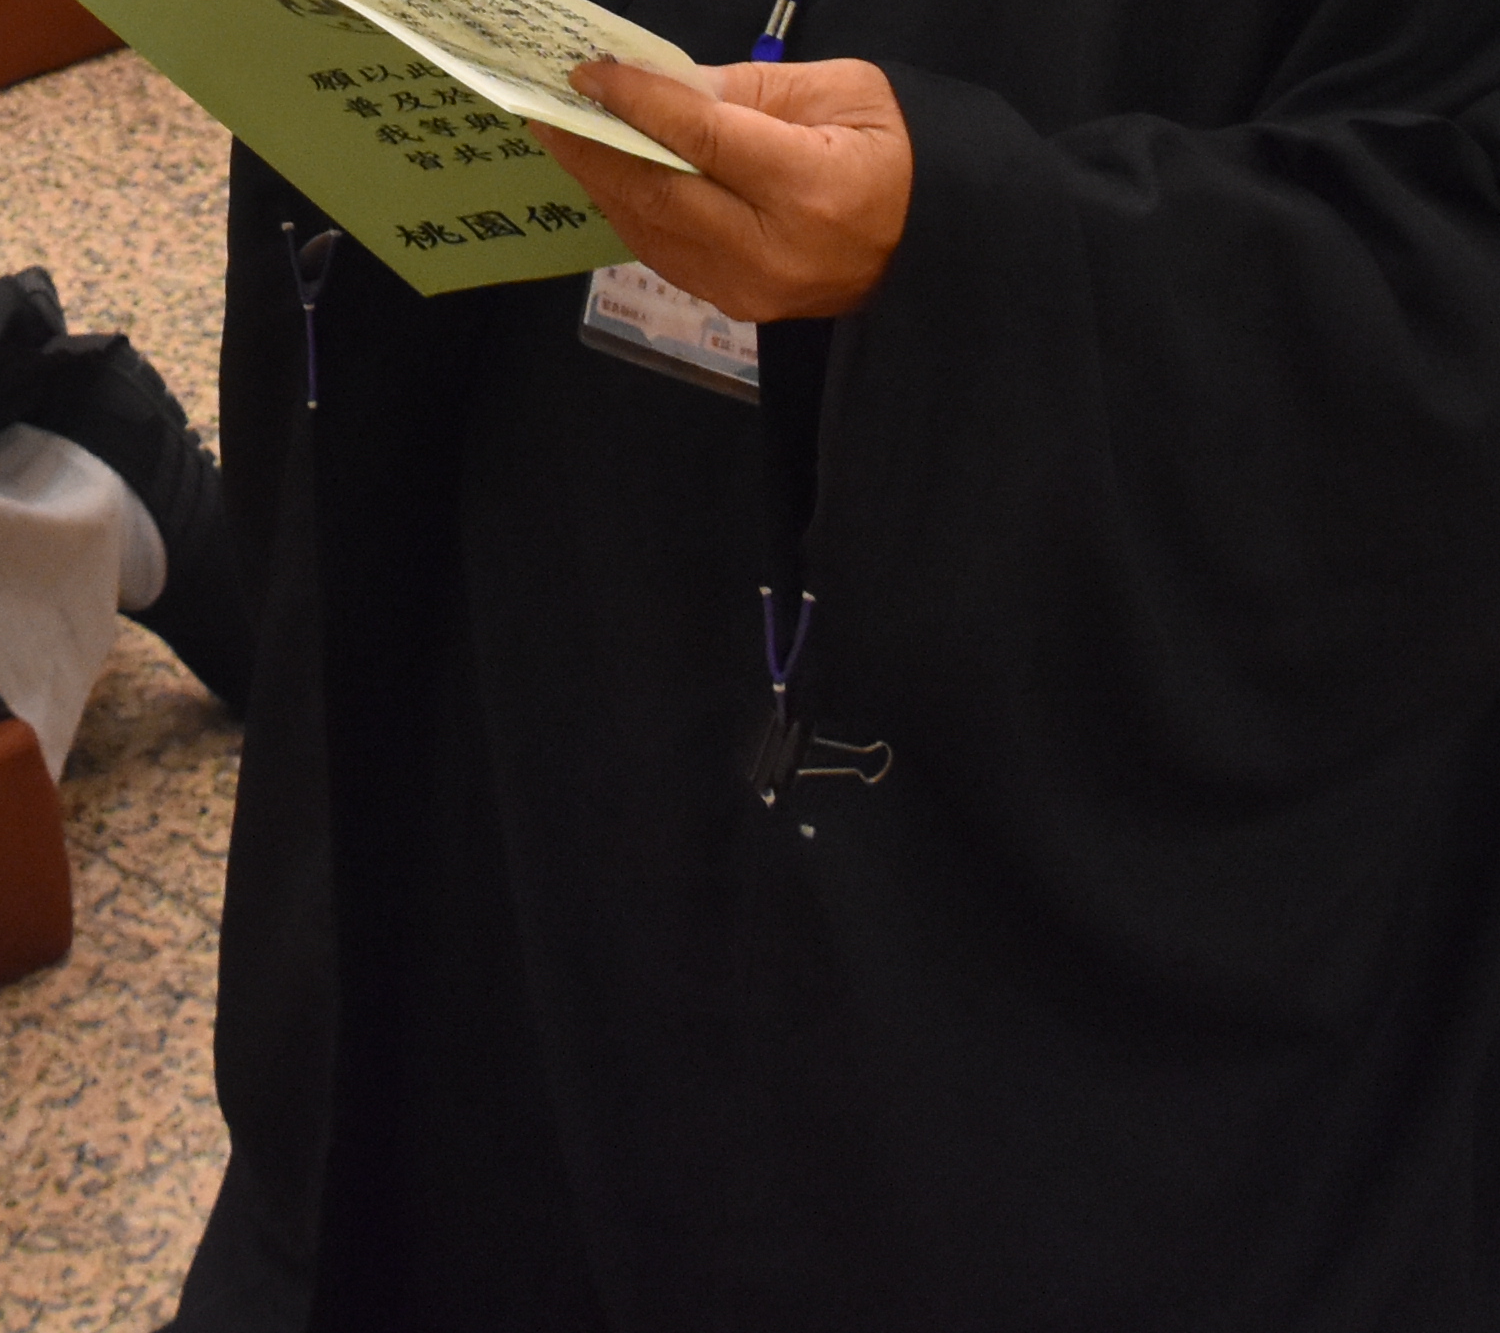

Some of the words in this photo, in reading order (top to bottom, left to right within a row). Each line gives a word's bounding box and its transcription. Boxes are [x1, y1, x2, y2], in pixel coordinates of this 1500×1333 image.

[376, 112, 529, 145] 我等與
[405, 137, 545, 170] 皆共成
[395, 201, 608, 250] 桃園佛
